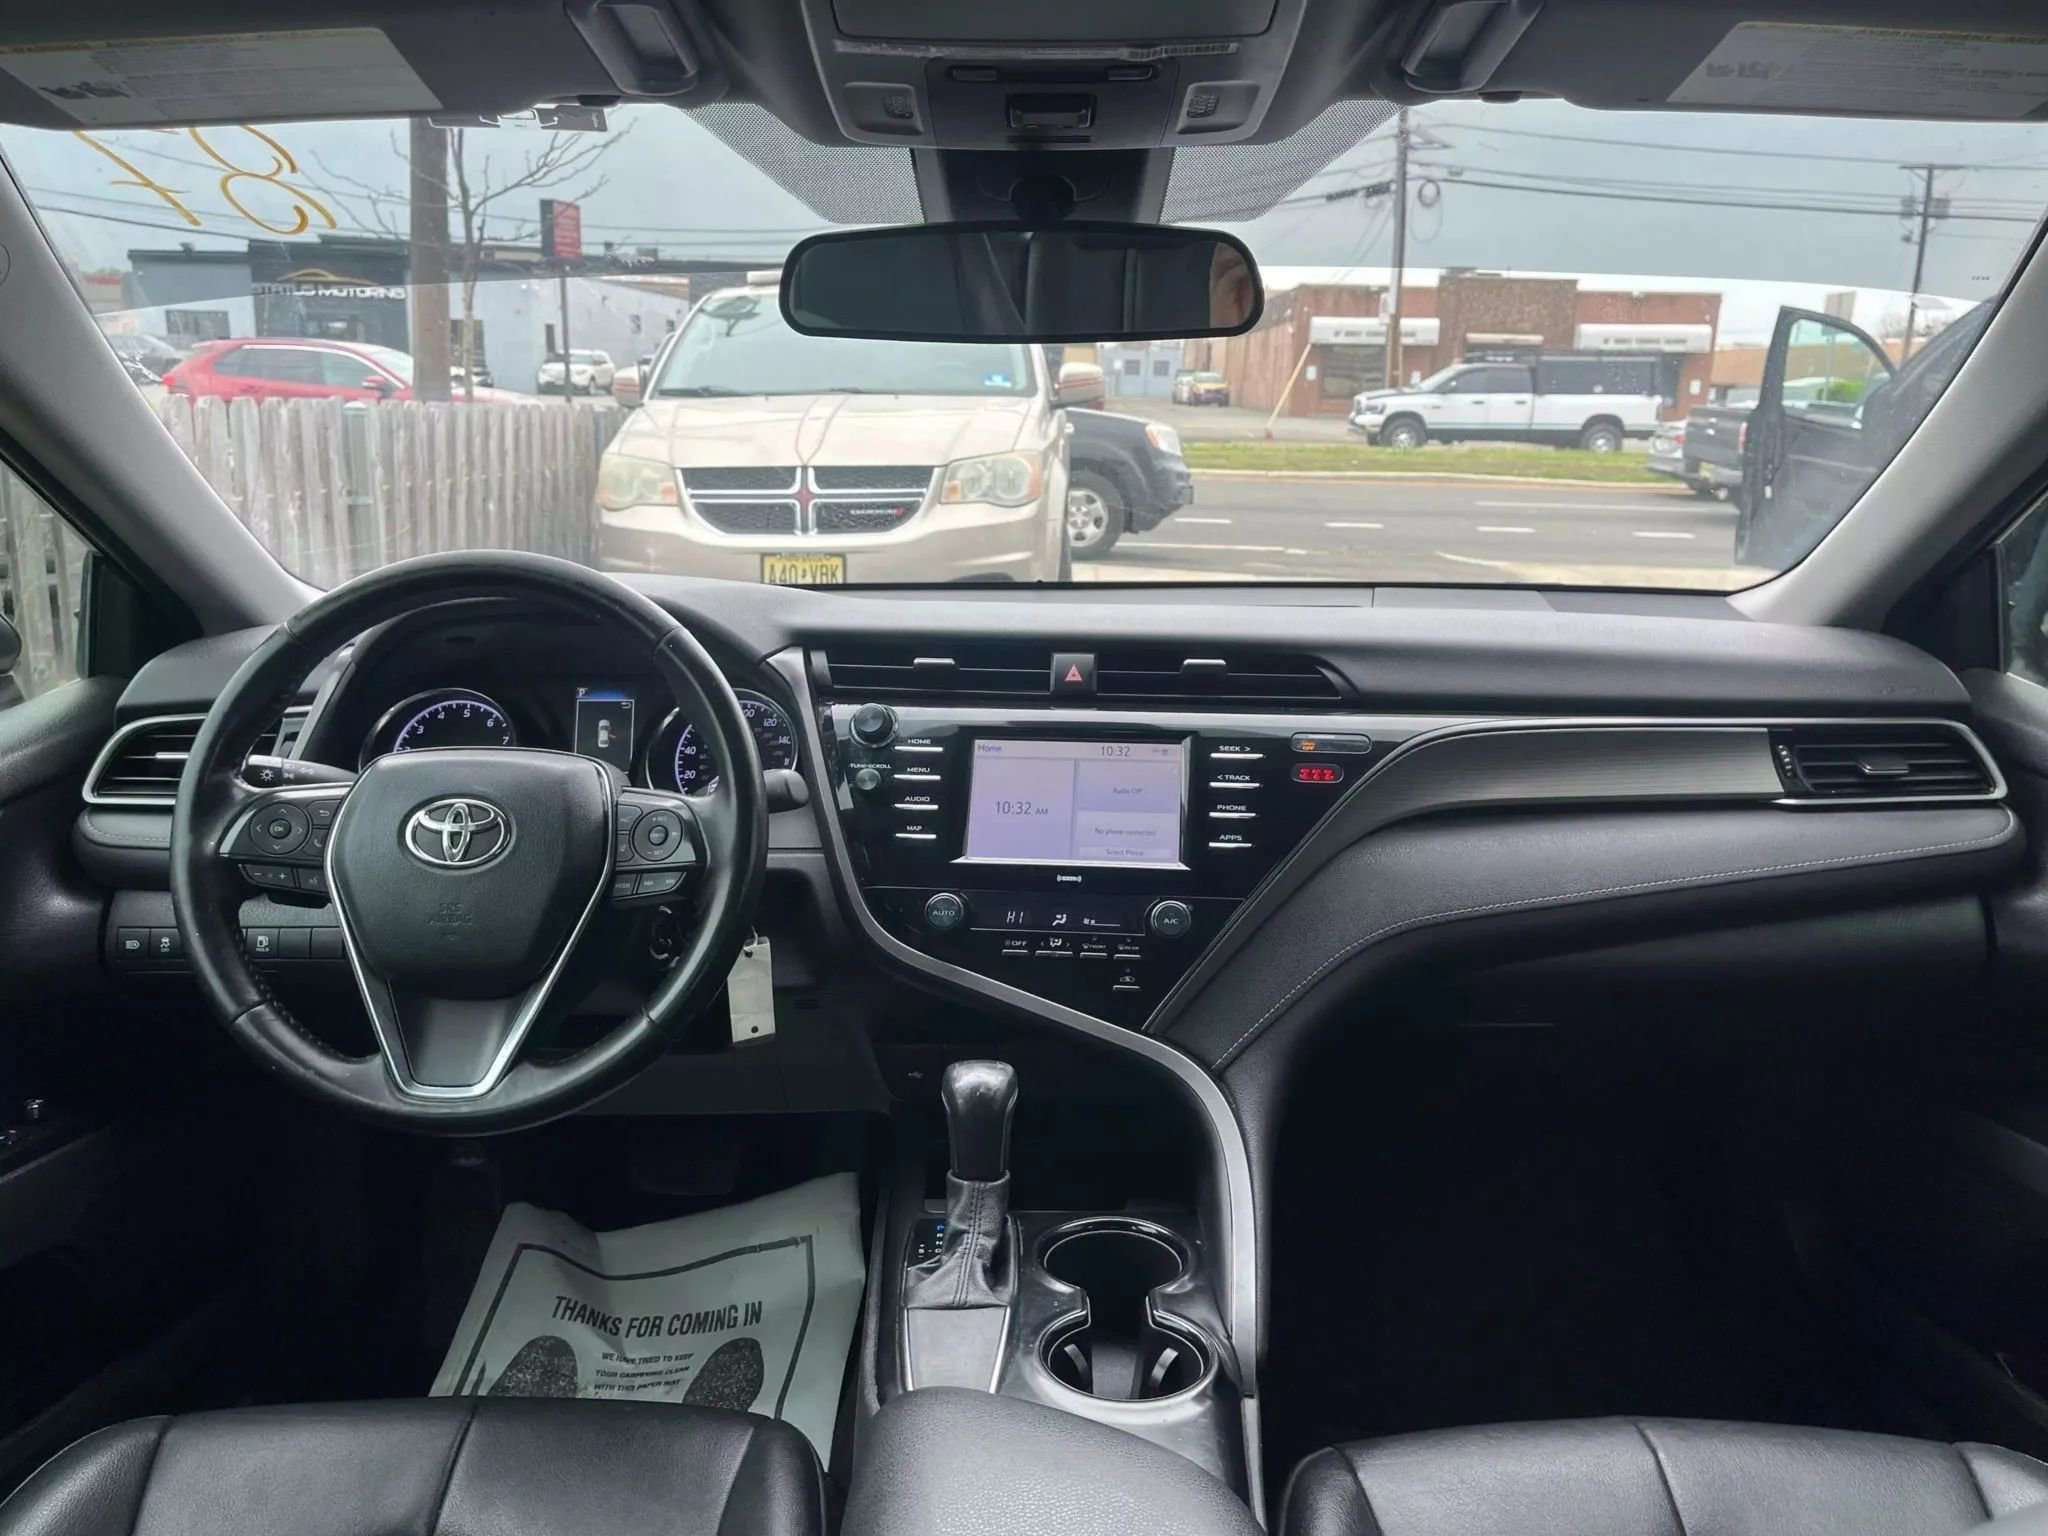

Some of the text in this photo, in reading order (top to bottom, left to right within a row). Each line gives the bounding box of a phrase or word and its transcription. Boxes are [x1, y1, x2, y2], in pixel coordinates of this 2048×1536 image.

[437, 711, 445, 720] 4
[463, 708, 471, 718] 5
[743, 709, 755, 718] 00
[486, 718, 495, 728] 6
[763, 718, 777, 727] 120
[416, 725, 425, 734] 3
[502, 736, 510, 745] 7
[684, 746, 697, 755] 40
[977, 743, 1002, 753] Home
[1100, 745, 1131, 757] 10:32
[684, 770, 696, 779] 20
[994, 800, 1049, 816] 10:32 AM
[274, 825, 285, 833] OK
[932, 909, 956, 917] AUTO
[1006, 911, 1024, 924] HI
[1163, 917, 1179, 925] A/C
[1011, 939, 1027, 947] OFF
[552, 1296, 763, 1339] THANKS FOR COMING IN
[602, 1352, 615, 1362] WE
[638, 1354, 661, 1365] TRIED
[674, 1352, 695, 1362] KEEP
[595, 1369, 618, 1378] YOUR
[664, 1365, 690, 1376] CLEAN
[594, 1383, 616, 1391] WITH
[617, 1383, 636, 1392] THIS
[637, 1381, 662, 1391] PAPER
